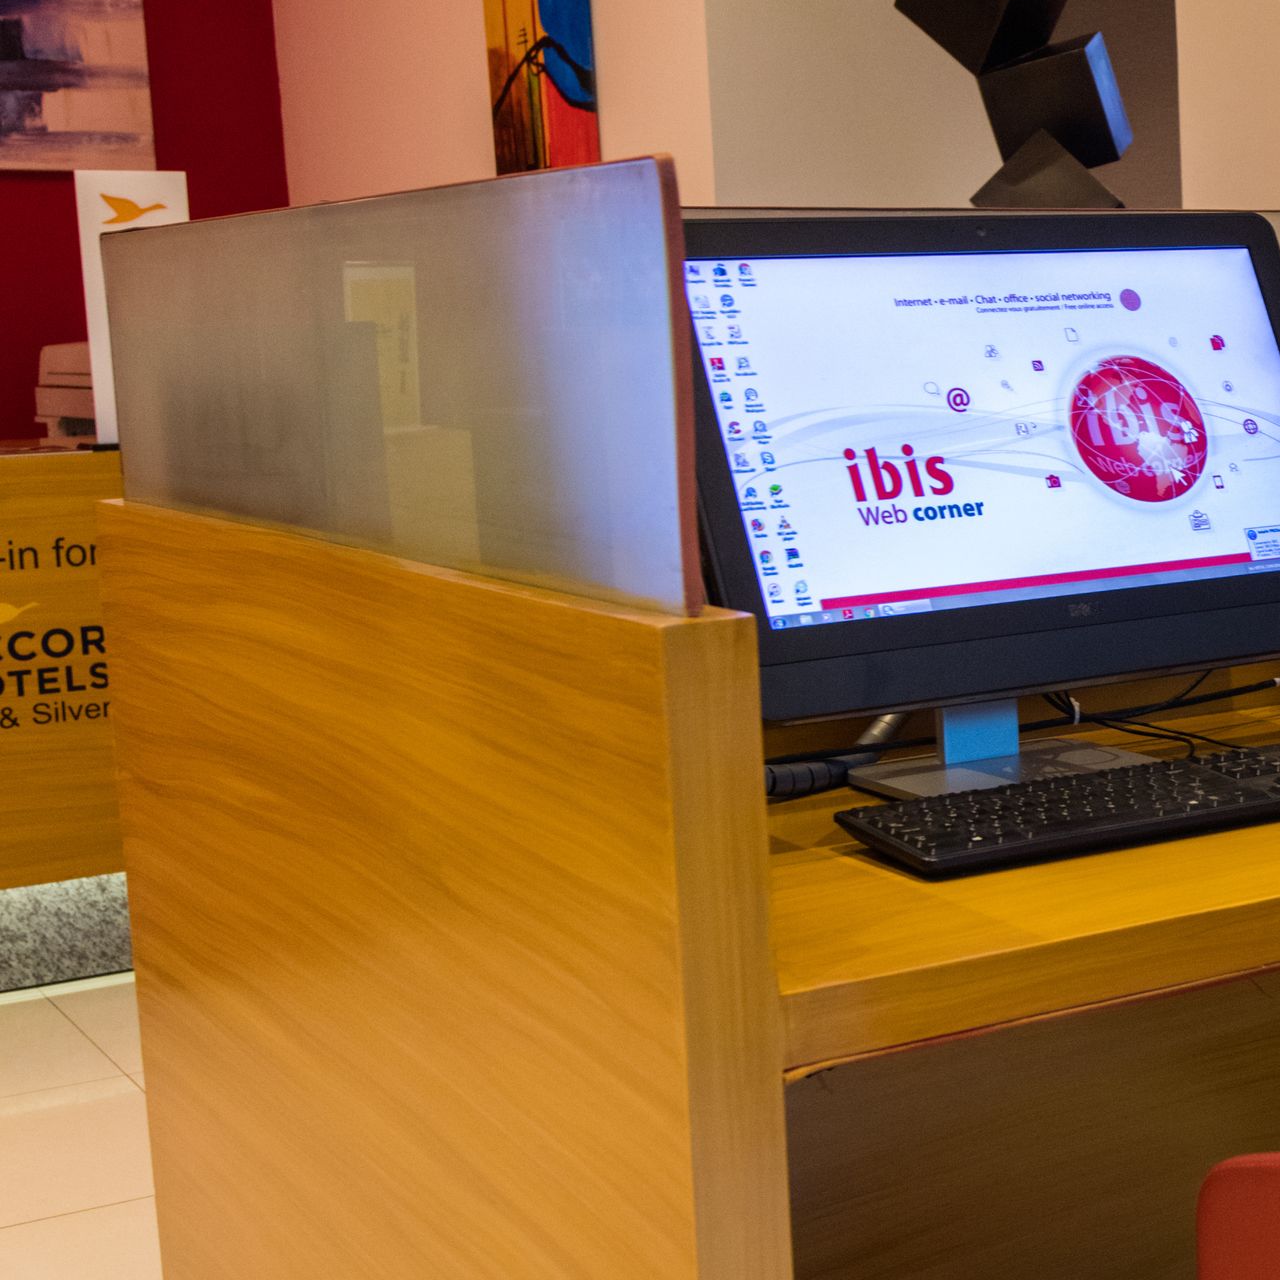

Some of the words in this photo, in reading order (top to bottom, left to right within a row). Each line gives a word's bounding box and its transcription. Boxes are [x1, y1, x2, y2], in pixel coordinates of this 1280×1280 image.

[894, 298, 934, 307] Internet
[939, 296, 969, 306] e-mail
[975, 295, 997, 304] Chat
[1003, 293, 1029, 303] office
[1034, 292, 1060, 302] social
[1061, 290, 1112, 302] networking
[843, 443, 955, 502] ibis
[857, 503, 908, 527] Web
[912, 501, 985, 522] corner
[0, 625, 106, 661] COR
[0, 662, 109, 698] TELS
[0, 706, 20, 729] &
[32, 701, 111, 725] Silver
